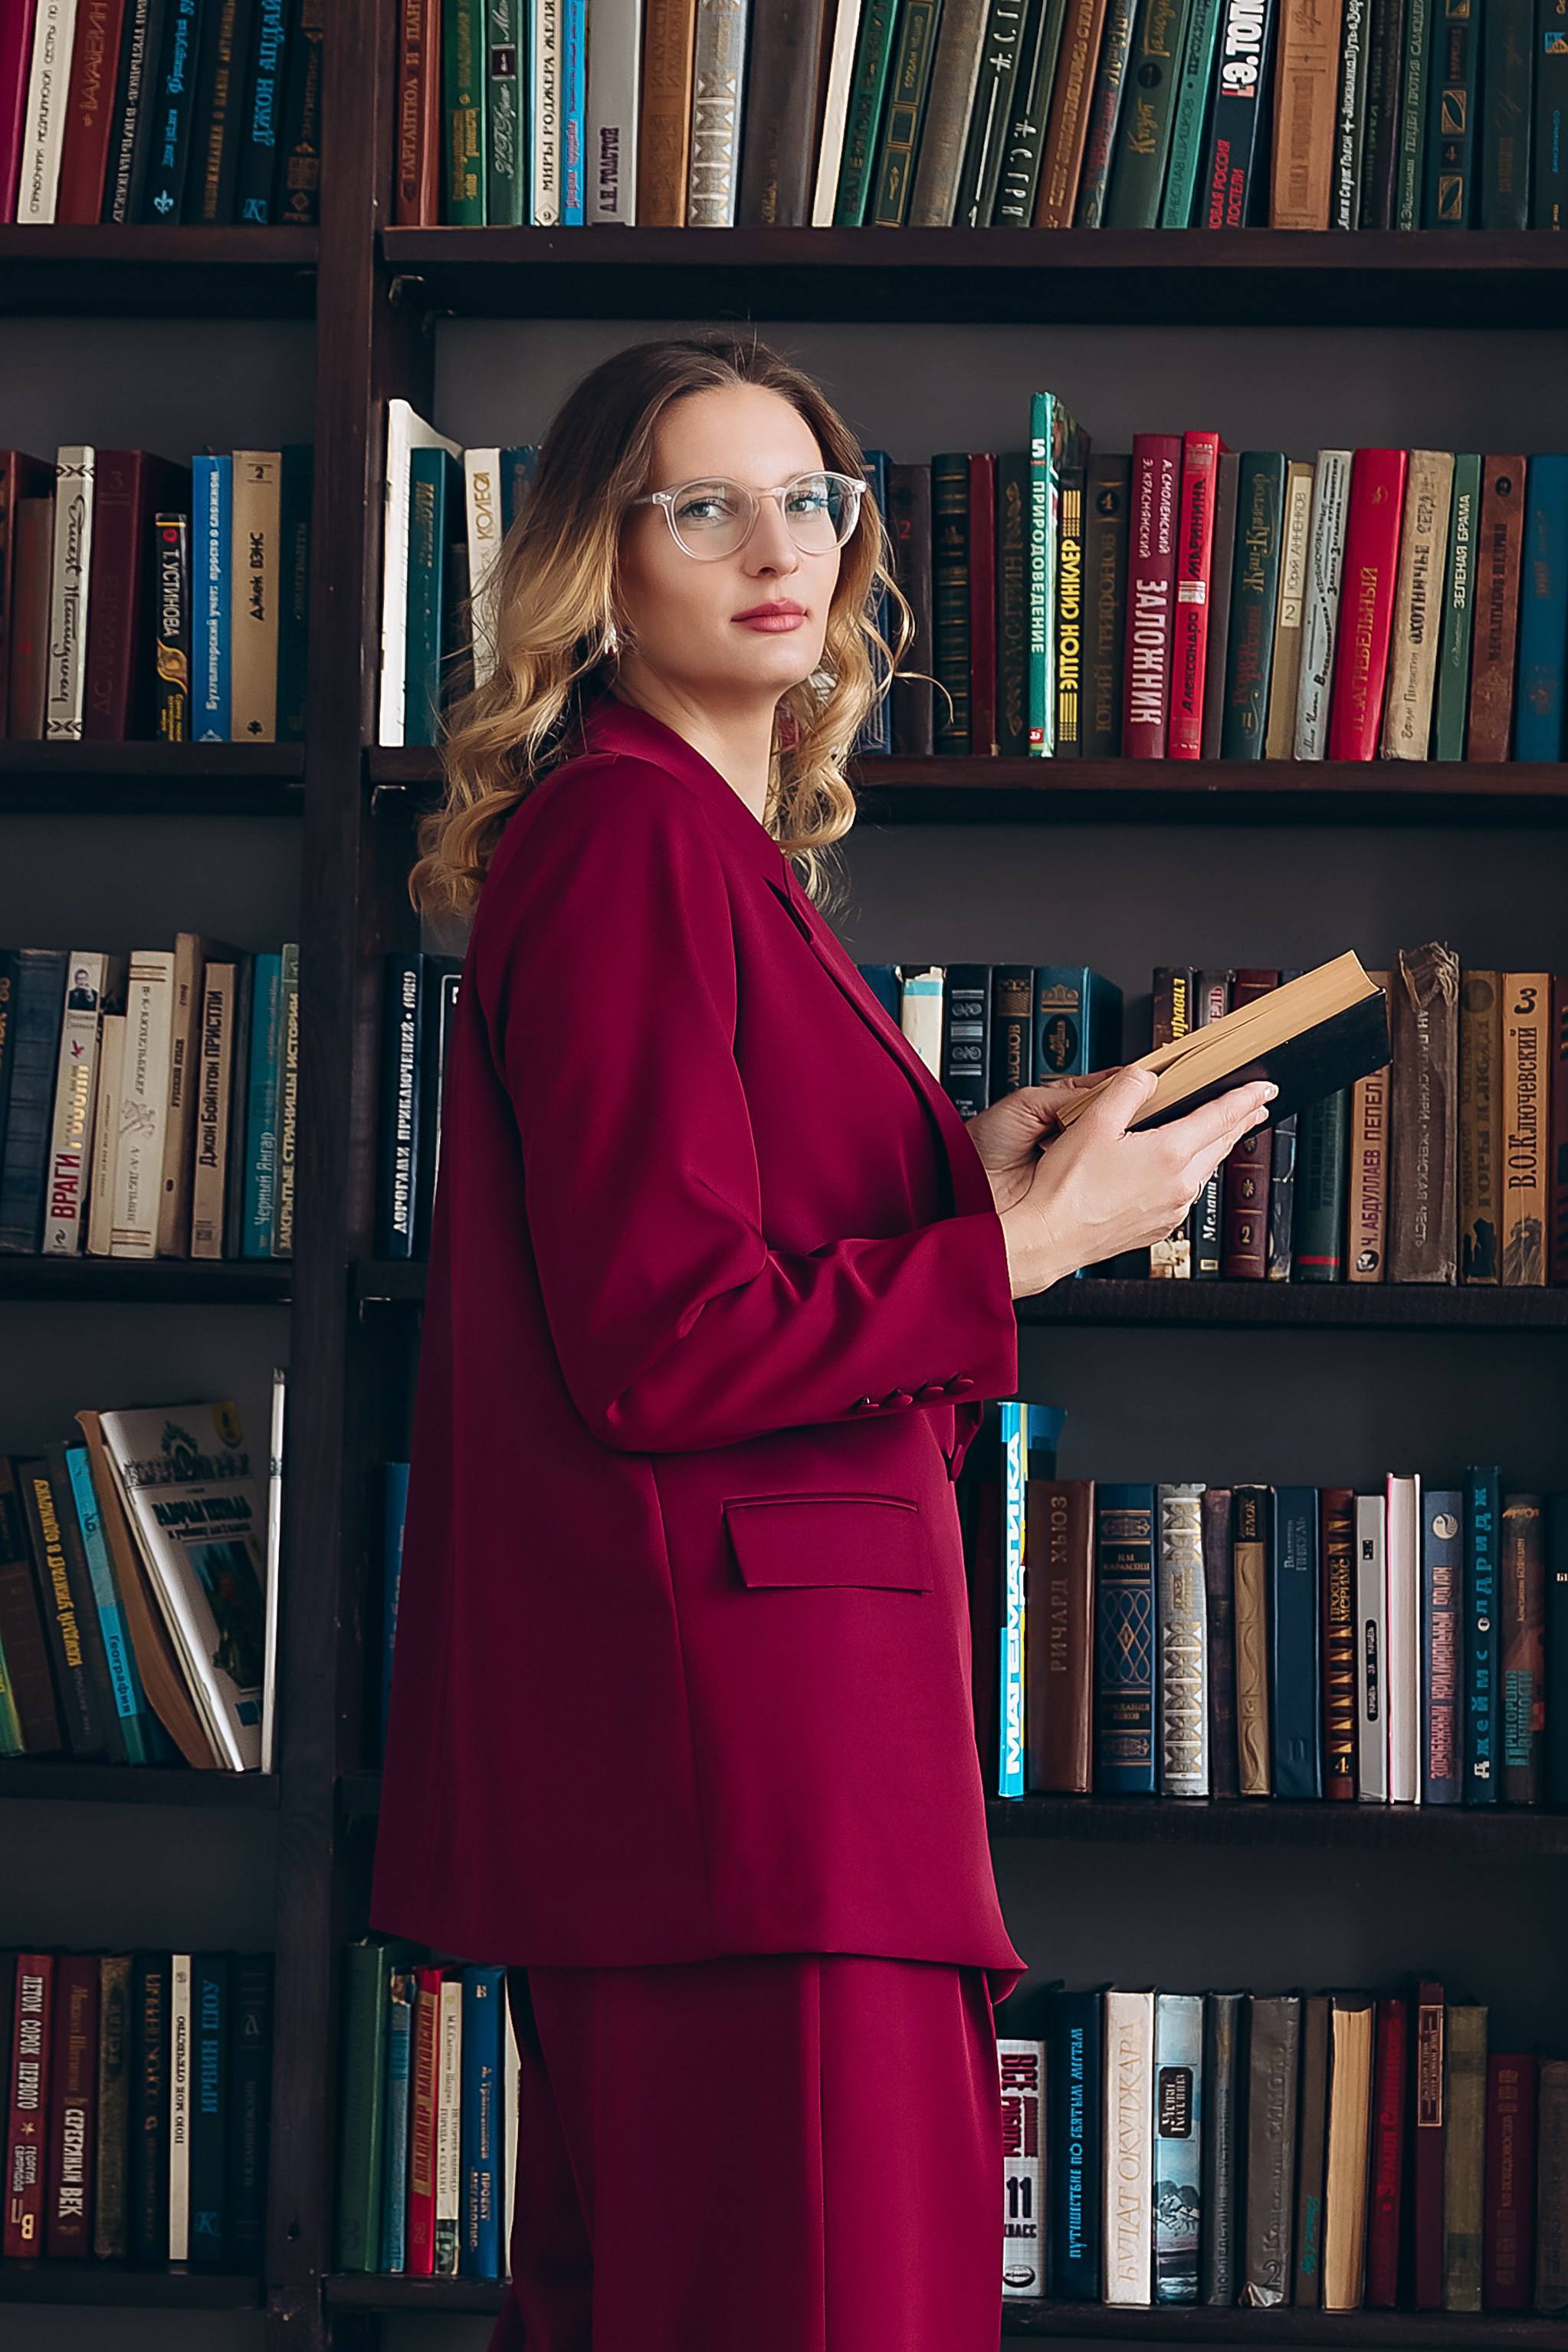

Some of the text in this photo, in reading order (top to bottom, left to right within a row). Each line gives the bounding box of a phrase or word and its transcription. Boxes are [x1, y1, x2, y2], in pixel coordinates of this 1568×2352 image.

[252, 79, 275, 147] ДЖОН
[402, 51, 419, 181] ГАРГАНТЮА И
[543, 56, 556, 190] МИРЫ РОДЖЕРА
[1126, 97, 1158, 154] Кнут
[1213, 139, 1231, 190] РОССИЯ
[1226, 168, 1245, 228] ПОСТЕЛИ
[1032, 438, 1046, 458] 5
[209, 471, 220, 528] сложном
[473, 472, 494, 540] КОЛЕСА
[1291, 491, 1306, 556] АННЕНКОВ
[1457, 494, 1471, 542] БРАМА
[51, 494, 86, 704] Ernest Hemingway
[209, 540, 221, 581] просто
[248, 532, 264, 622] Джек ВЭНС
[1030, 481, 1045, 654] ПРИРОДОВЕДЕНИЕ
[1181, 477, 1206, 714] Александра МАРИНИНА
[1409, 544, 1430, 645] ОХОТНИЧЬЕ
[1453, 545, 1468, 609] ЗЕЛЕНАЯ
[162, 562, 180, 638] УСТИНОВА
[1060, 539, 1081, 691] ЭПТОН СИНКЛЕР
[1093, 533, 1117, 733] ЮРИЙ ТРИФОНОВ
[205, 619, 221, 710] Бухгалтерский
[1130, 579, 1169, 725] ЗАЛОЖНИК
[1513, 988, 1538, 1015] 3
[199, 990, 223, 1168] Джон Бойнтон ПРИСТЛИ
[396, 1022, 415, 1140] ПРИКЛЮЧЕНИЙ
[1007, 1023, 1023, 1087] ЛЕСКОВ
[256, 1131, 276, 1171] Янгар
[277, 992, 299, 1249] ЗАКРЫТЫЕ СТРАНИЦЫ ИСТОРИИ
[51, 1153, 80, 1219] ВРАГИ
[253, 1175, 274, 1225] Черный
[393, 1146, 411, 1234] ДОРОГАМИ
[1360, 1082, 1383, 1247] Ч. АБДУЛЛАЕВ ПЕПЕЛ
[1202, 1181, 1218, 1242] Мелани
[1005, 1432, 1021, 1776] МАТЕМАТИКА
[1050, 1495, 1069, 1672] РИЧАРД ХЬЮЗ
[57, 1610, 83, 1667] КАЖДЫЙ
[107, 1634, 131, 1714] География
[1471, 1648, 1491, 1779] Джеймс
[17, 1975, 43, 2110] ЛЕТОМ СОРОК ПЕРВОГО
[175, 2016, 186, 2144] ПОЮ МОЕ ОТЕЧЕСТВО
[200, 1979, 220, 2114] ИРВИН ШОУ
[1000, 2054, 1038, 2091] ВСЕ
[415, 2003, 435, 2183] ВЛАДИМИР МАЯКОВСКИЙ
[62, 2108, 85, 2183] СЕРЕБРЯНЫЙ
[1116, 2017, 1144, 2282] БУЛАТ ОКУДЖАВА
[1377, 2130, 1397, 2196] Земля
[57, 2186, 84, 2218] ВЕК
[481, 2171, 491, 2221] ПРОЕКТ
[1006, 2176, 1033, 2219] 11
